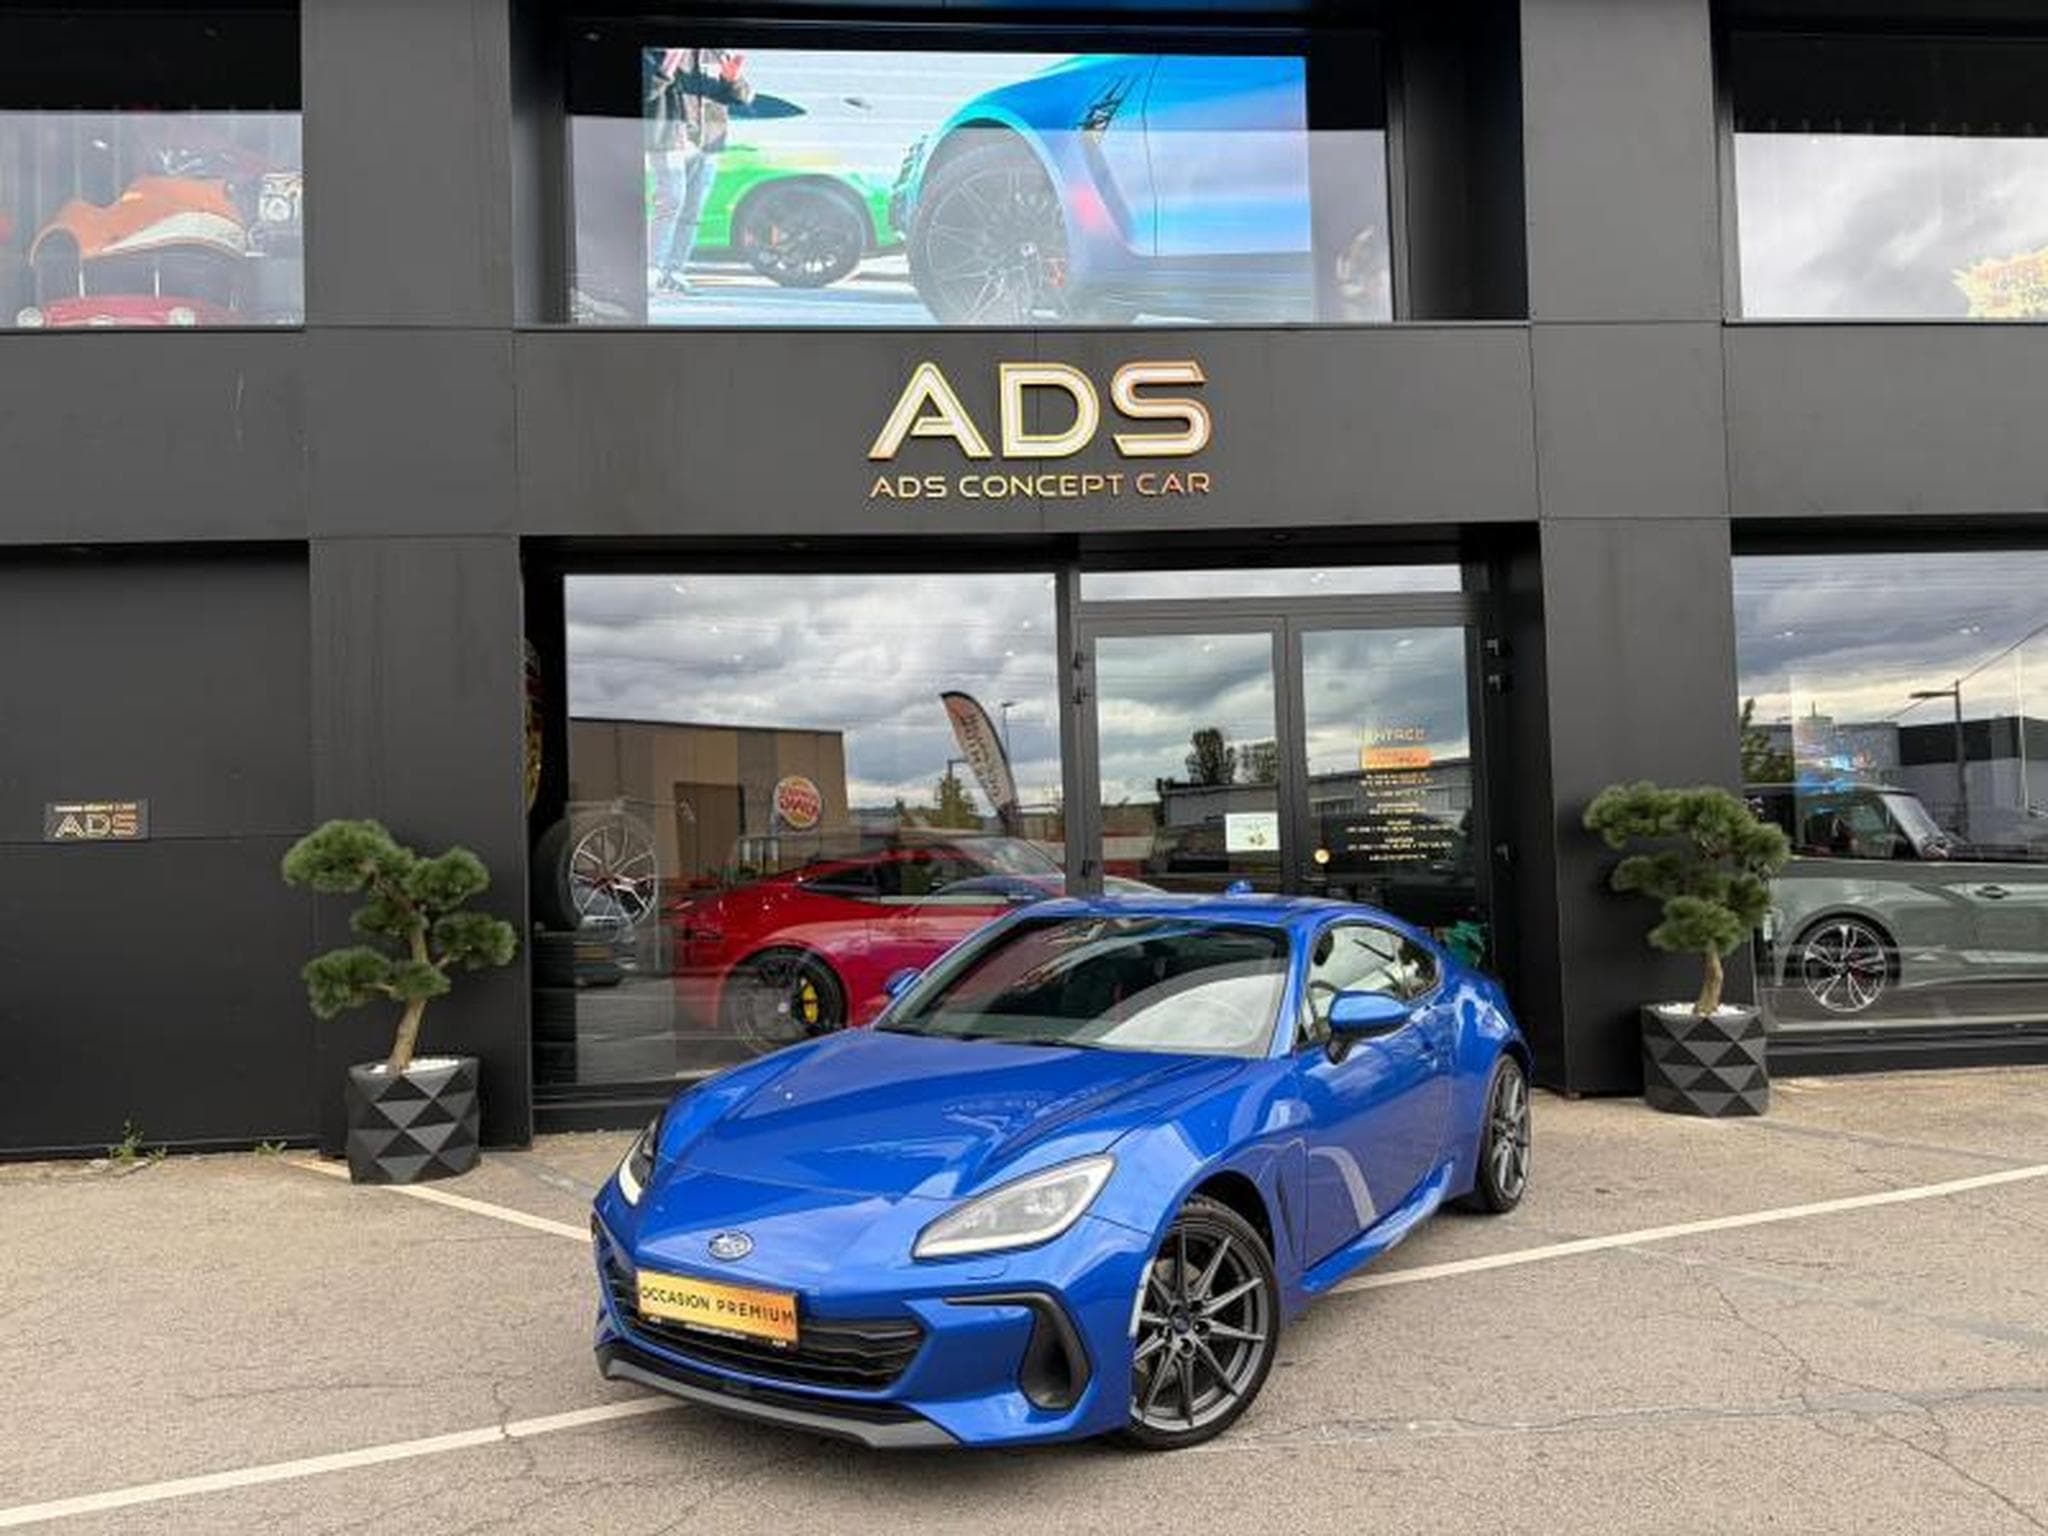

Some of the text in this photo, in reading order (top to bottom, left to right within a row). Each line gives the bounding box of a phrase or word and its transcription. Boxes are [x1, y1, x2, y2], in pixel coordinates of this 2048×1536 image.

[868, 361, 1213, 459] ADS
[870, 472, 1211, 498] ADS CONCEPT CAR
[54, 814, 137, 838] ADS
[641, 1286, 795, 1325] OCCASION PREMIUM
